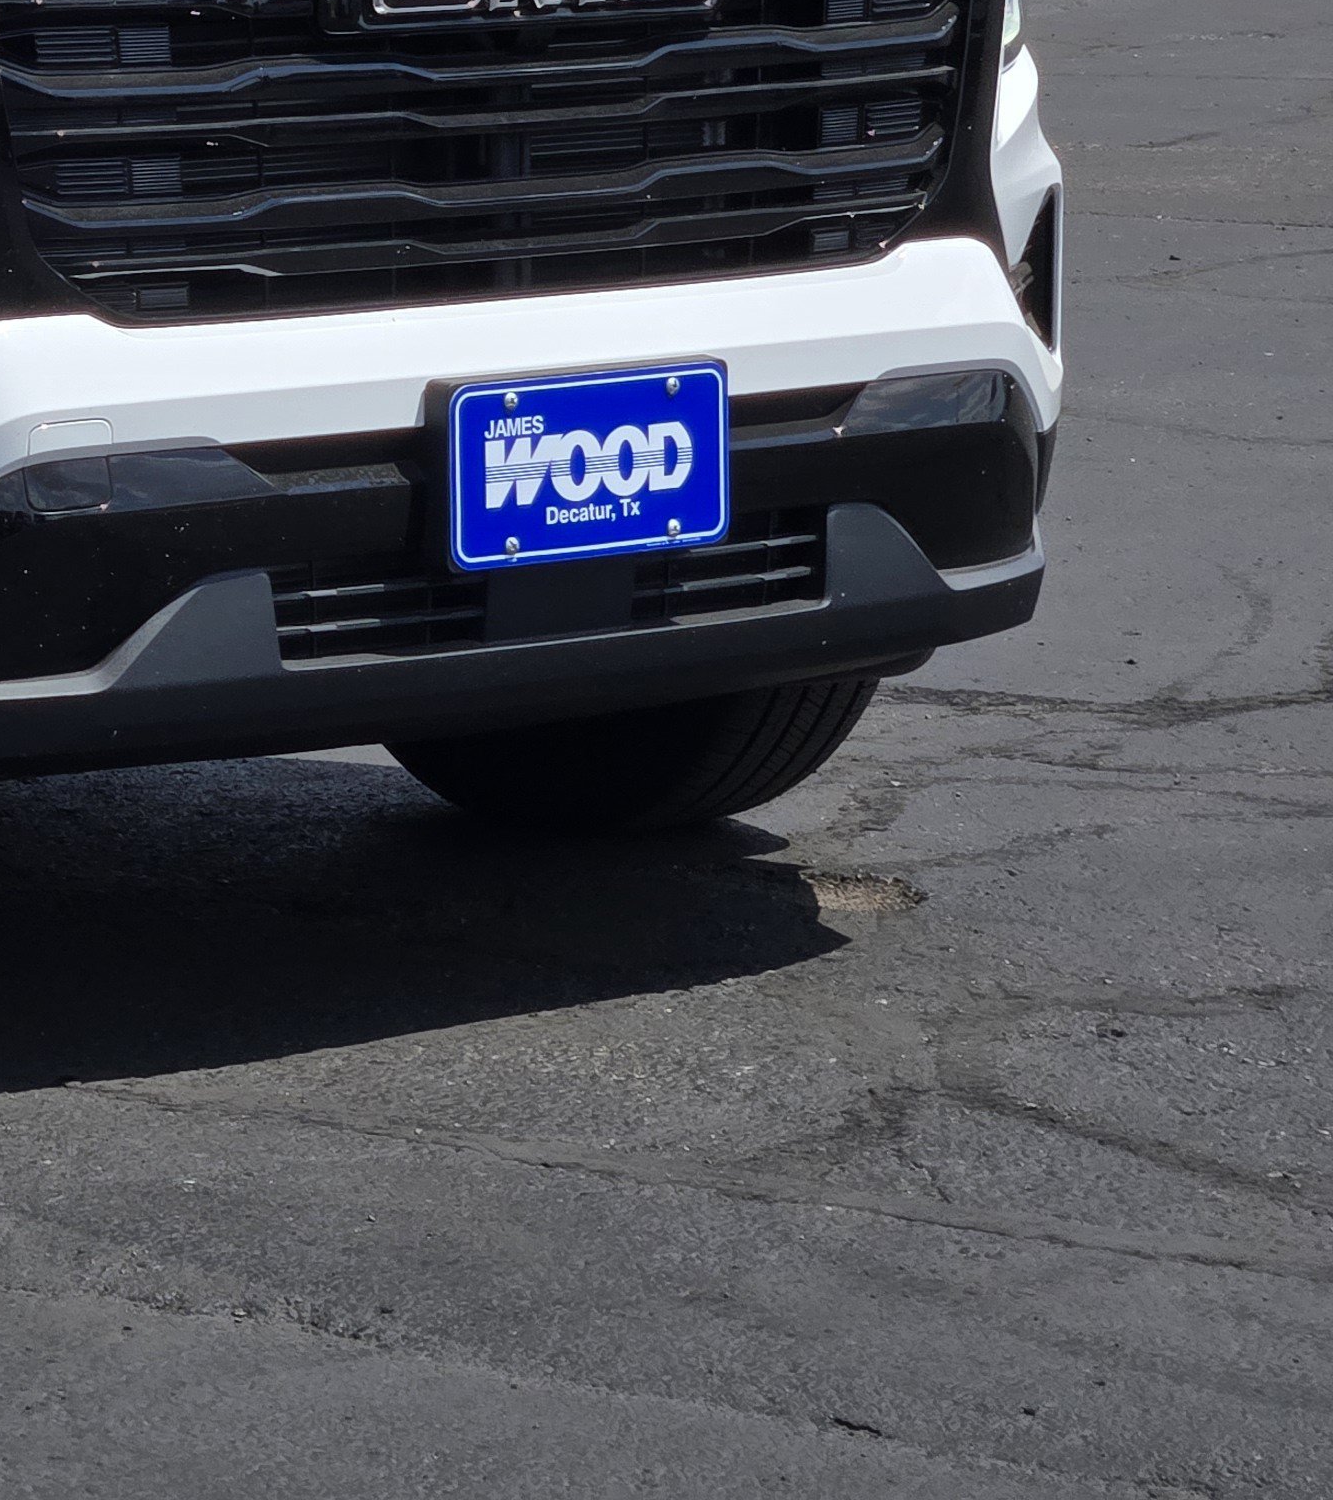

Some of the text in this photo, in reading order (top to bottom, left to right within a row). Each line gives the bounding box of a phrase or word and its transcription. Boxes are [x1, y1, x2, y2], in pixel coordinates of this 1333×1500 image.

[484, 414, 544, 439] JAMES
[484, 421, 693, 510] WOOD
[546, 498, 641, 525] Decatur, Tx
